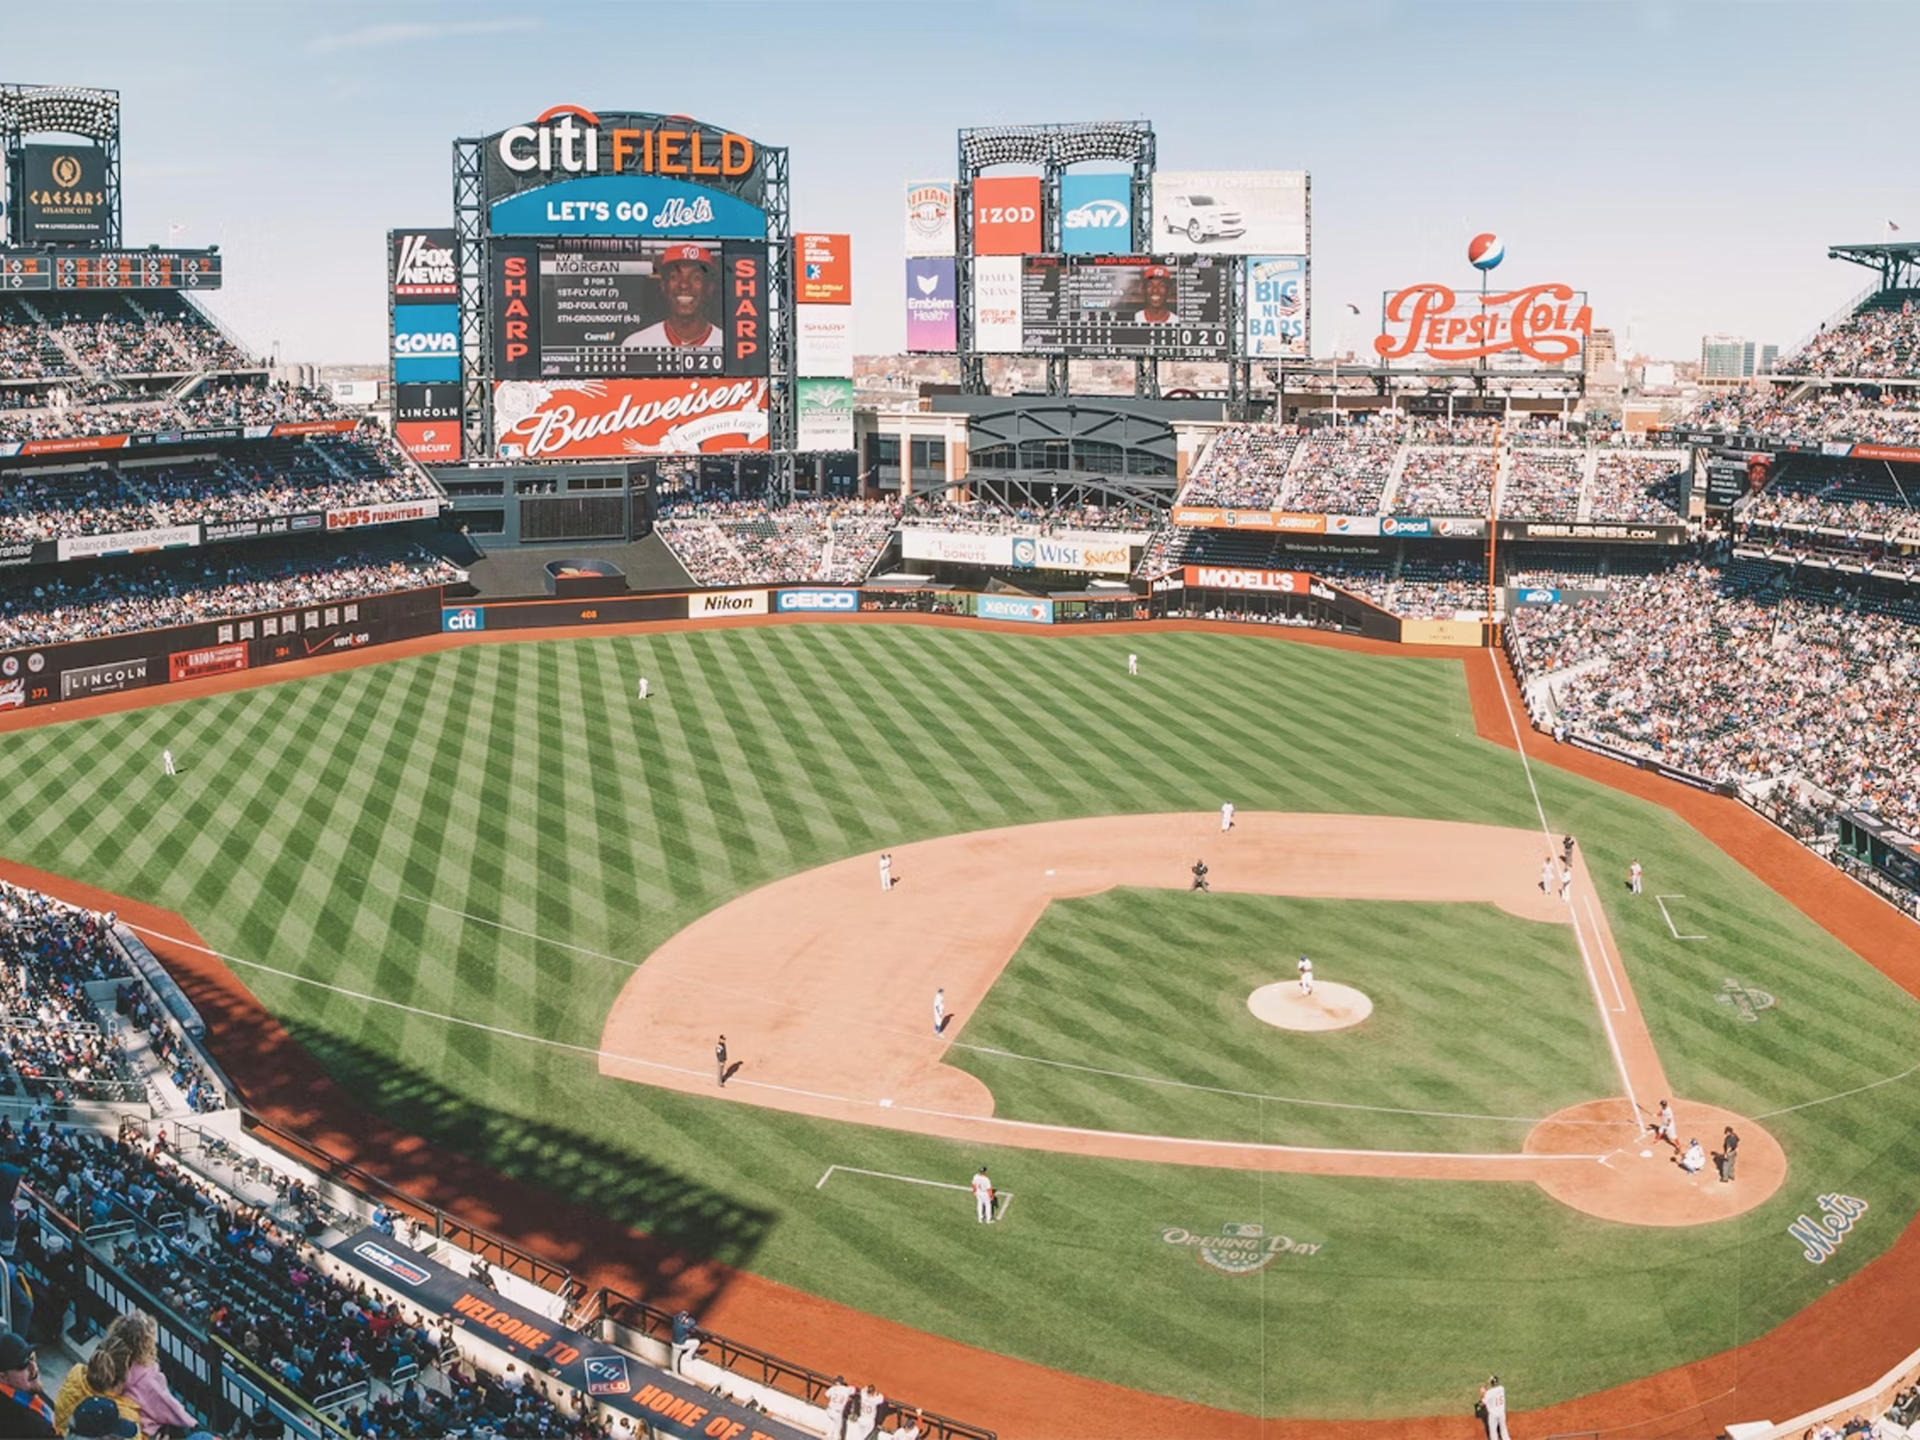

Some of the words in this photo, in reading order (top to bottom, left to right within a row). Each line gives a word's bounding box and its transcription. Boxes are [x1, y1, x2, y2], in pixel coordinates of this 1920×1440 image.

[612, 128, 754, 176] FIELD
[30, 190, 103, 206] CAESARS
[547, 202, 610, 221] LET'S
[616, 202, 648, 222] GO
[652, 196, 715, 228] Mets
[979, 207, 1035, 224] IZOD
[1064, 204, 1122, 229] SNY
[415, 248, 454, 267] FOX
[555, 262, 620, 272] MORGAN
[404, 267, 456, 284] NEWS
[1256, 280, 1298, 303] BIG
[504, 256, 529, 363] SHARP
[734, 259, 758, 360] SHARP
[908, 298, 954, 311] Emblem
[913, 310, 950, 321] Health
[1250, 319, 1302, 336] BARS
[394, 332, 458, 354] GOYA
[1182, 330, 1192, 345] 0
[1198, 330, 1208, 345] 2
[1215, 330, 1225, 345] 0
[684, 356, 694, 369] 0
[699, 356, 708, 369] 2
[712, 356, 722, 369] 0
[400, 407, 458, 418] LINCOLN
[512, 381, 753, 456] Budweiser
[328, 510, 370, 528] BOB'S
[372, 507, 424, 522] FURNITURE
[1397, 521, 1428, 534] pepsi
[69, 539, 108, 552] Alliance
[110, 534, 148, 550] Building
[151, 530, 191, 544] Services
[944, 550, 986, 560] DONUTS
[1040, 543, 1078, 564] WISE
[1083, 548, 1127, 566] SNACKS
[1198, 568, 1294, 592] MODELL'S
[704, 594, 754, 611] Nikon
[780, 592, 854, 609] GEICO
[985, 602, 1029, 617] xerox
[448, 611, 476, 630] citi
[333, 632, 370, 648] verizon
[72, 666, 146, 688] LINCOLN
[1788, 1192, 1869, 1264] Mets
[1162, 1227, 1260, 1251] OPENING
[1267, 1235, 1322, 1256] DAY
[360, 1245, 421, 1283] mets.com
[452, 1292, 551, 1350] WELCOME
[543, 1340, 582, 1366] TO
[590, 1380, 627, 1392] FIELD
[632, 1384, 710, 1429] HOME
[704, 1415, 746, 1440] OF
